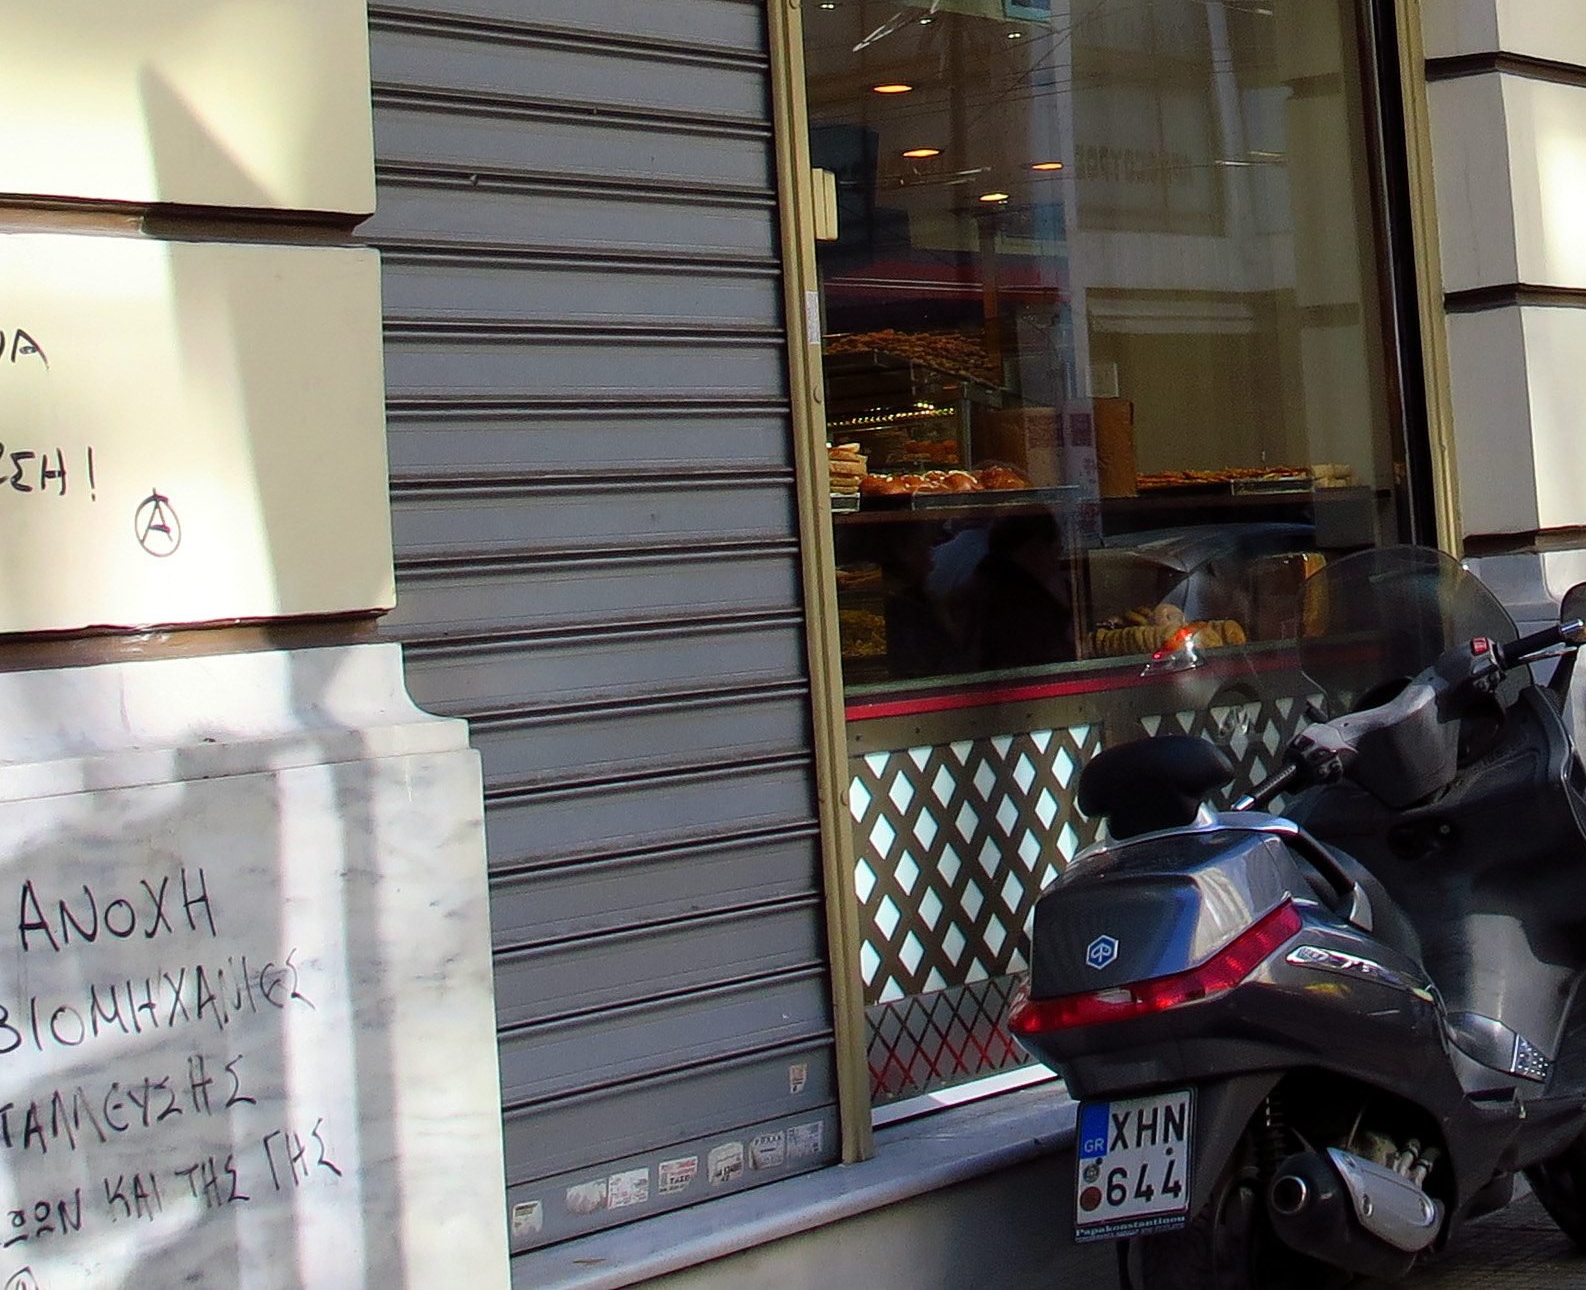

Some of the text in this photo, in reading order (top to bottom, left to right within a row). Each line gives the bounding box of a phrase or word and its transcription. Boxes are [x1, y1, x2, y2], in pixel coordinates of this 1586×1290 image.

[18, 867, 218, 952] ΑΝΟΧΗ
[1084, 1102, 1186, 1154] GR XHN
[103, 1171, 164, 1223] ΚΑΙ
[174, 1154, 250, 1210] ΤΗΣ
[262, 1117, 343, 1191] ΓΗΣ
[1106, 1159, 1183, 1207] 644
